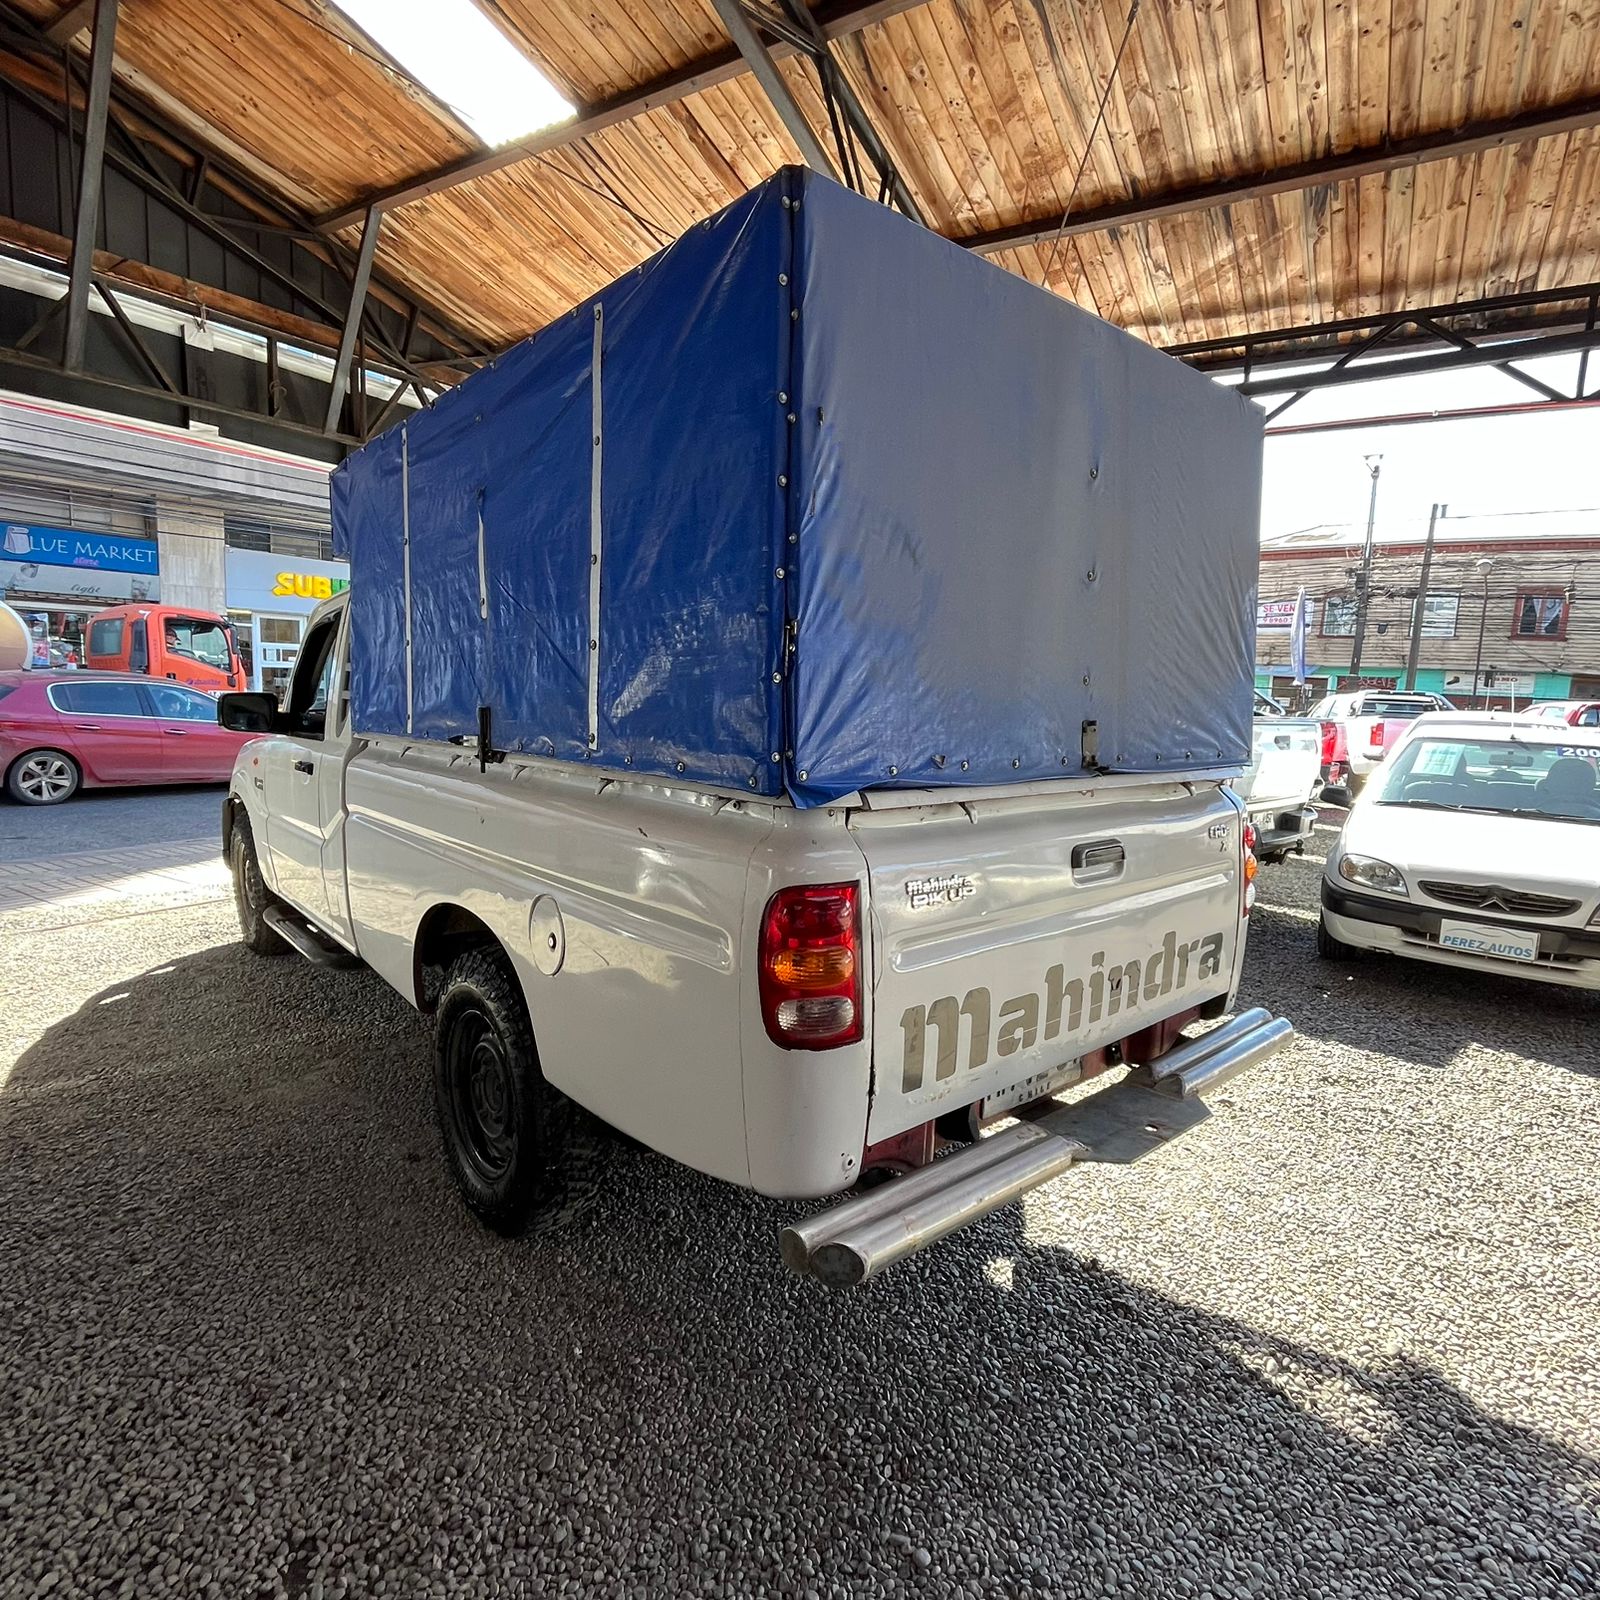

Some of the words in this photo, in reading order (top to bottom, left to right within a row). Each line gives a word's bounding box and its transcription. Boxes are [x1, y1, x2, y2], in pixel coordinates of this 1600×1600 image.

[75, 541, 156, 563] MARKET
[1263, 604, 1275, 613] SE
[1277, 603, 1296, 613] VEN
[1443, 935, 1486, 950] PEREZ
[1488, 943, 1533, 958] AUTOS
